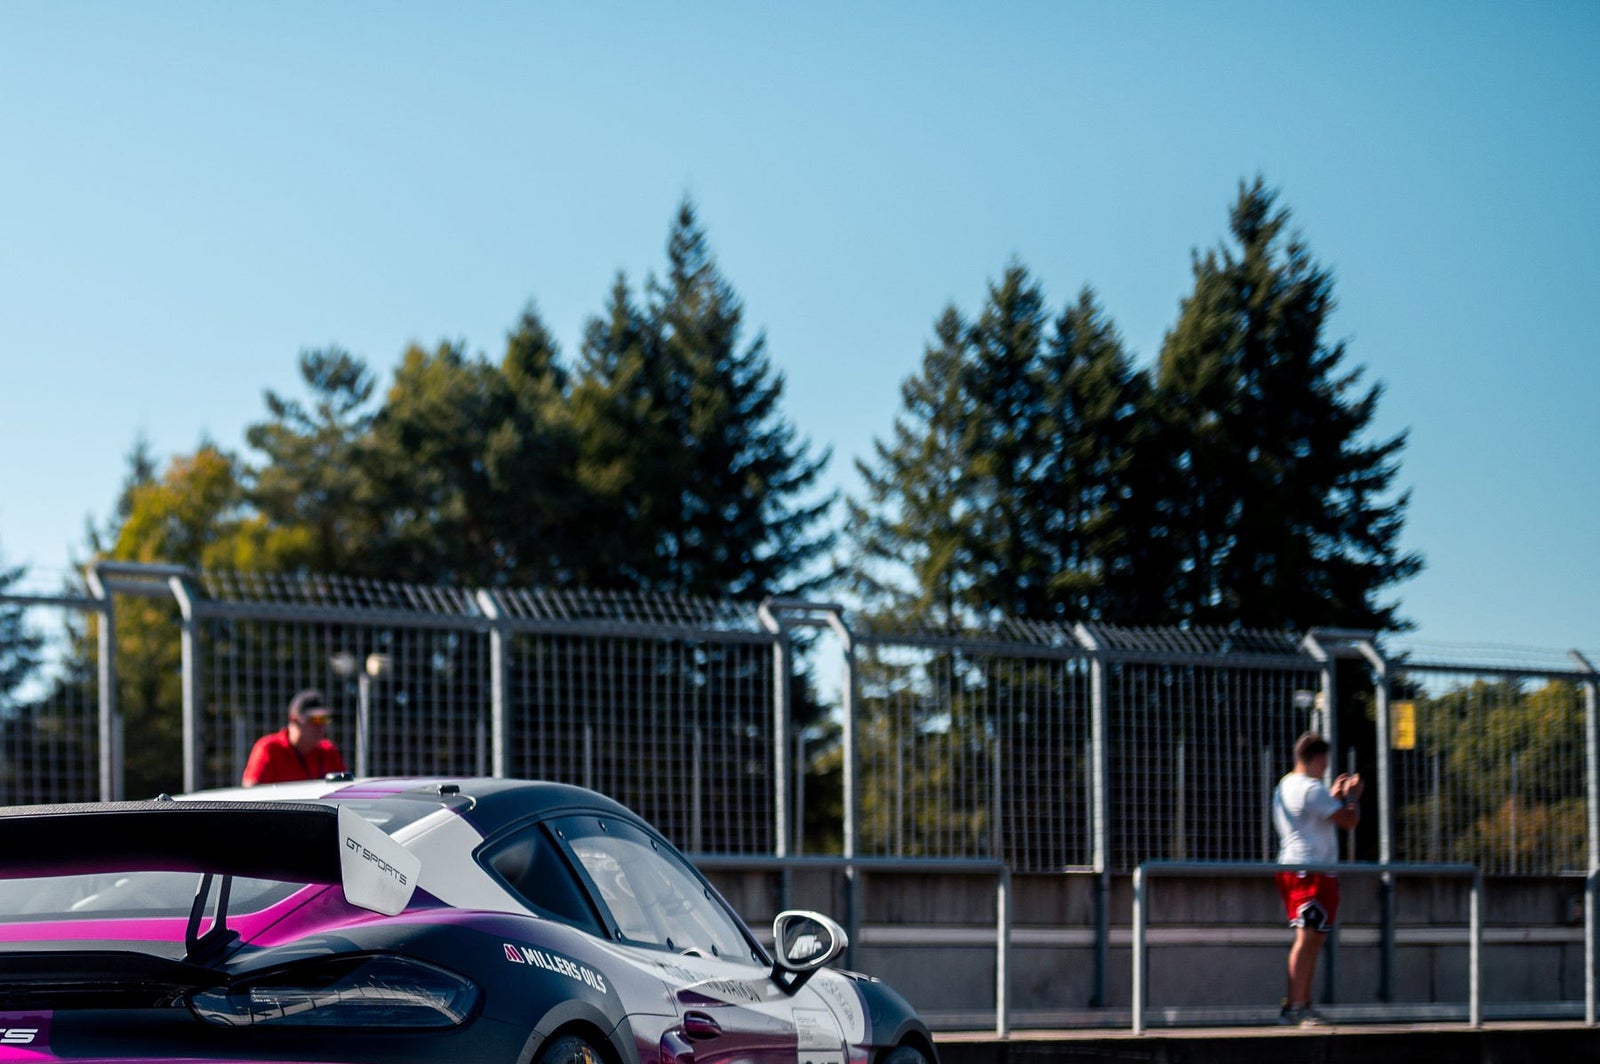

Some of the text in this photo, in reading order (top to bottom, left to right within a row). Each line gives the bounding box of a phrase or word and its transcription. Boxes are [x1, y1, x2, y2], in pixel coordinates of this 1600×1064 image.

[346, 837, 408, 886] GT SPORTS
[520, 946, 607, 994] MILLERS OILS
